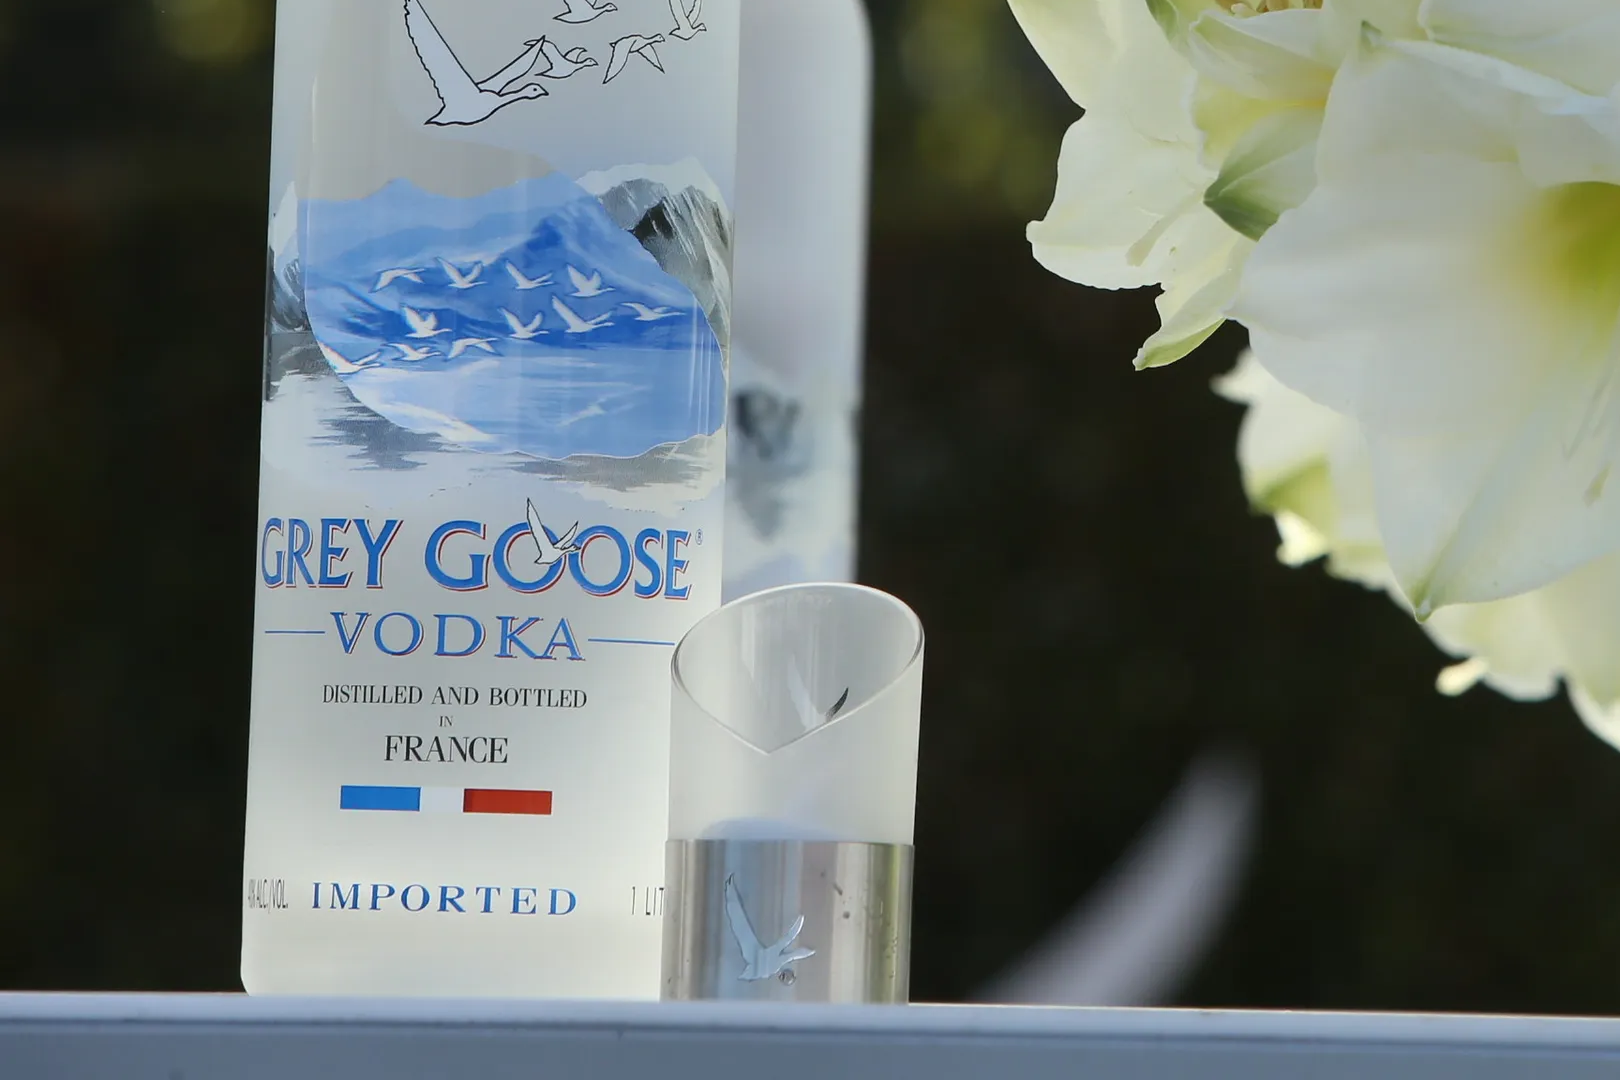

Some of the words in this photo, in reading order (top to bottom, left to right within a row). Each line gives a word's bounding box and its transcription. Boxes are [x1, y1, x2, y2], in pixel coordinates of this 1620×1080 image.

[261, 517, 404, 590] GREY
[424, 518, 693, 600] GOOSE
[330, 611, 586, 661] VODKA
[322, 684, 424, 705] DISTILLED
[431, 687, 480, 706] AND
[489, 689, 588, 709] BOTTLED
[438, 715, 454, 728] IN
[384, 735, 509, 764] FRANCE
[312, 882, 578, 916] IMPORTED
[645, 886, 665, 916] LIT
